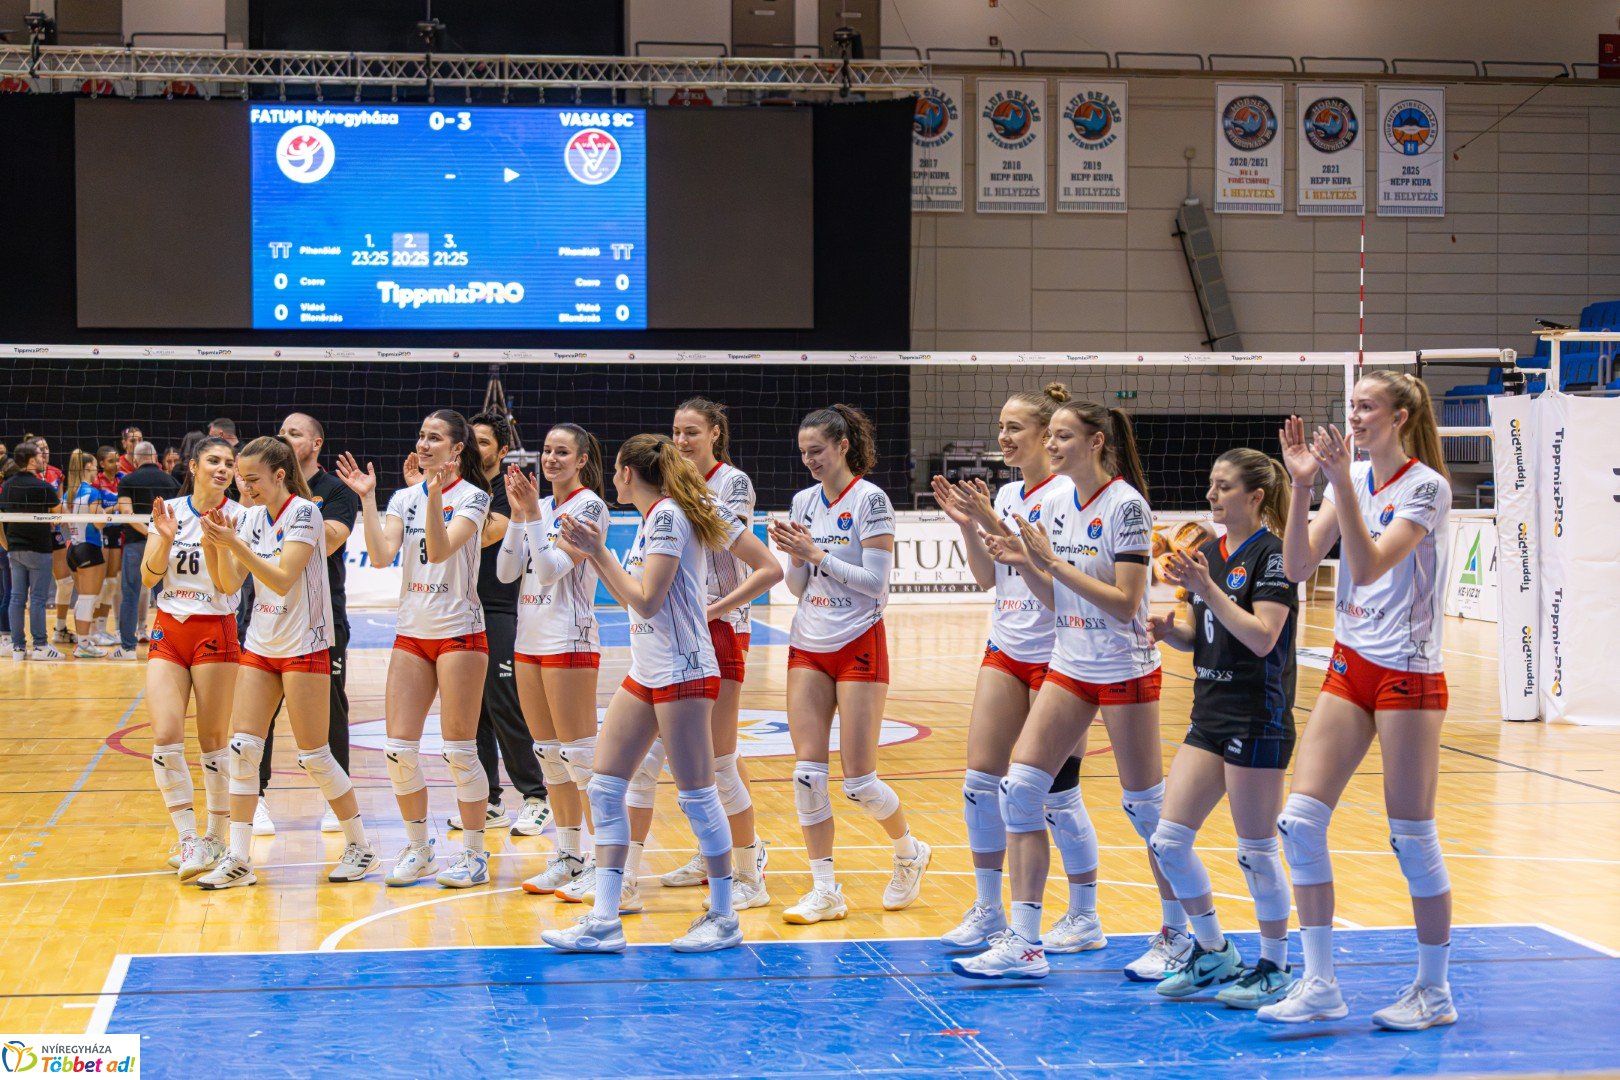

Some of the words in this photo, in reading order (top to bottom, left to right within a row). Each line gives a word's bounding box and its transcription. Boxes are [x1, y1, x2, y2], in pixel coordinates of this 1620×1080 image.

[250, 109, 302, 124] FATUM
[305, 109, 399, 127] Nyíregyháza
[559, 112, 610, 127] VASAS
[612, 112, 634, 127] SC
[1083, 161, 1102, 170] 2019
[1402, 166, 1420, 175] 2025
[912, 171, 928, 180] EPP
[991, 173, 1011, 181] HEPP
[1013, 173, 1033, 181] KUPA
[1071, 173, 1091, 181] HEPP
[1311, 176, 1330, 184] HEPP
[1332, 177, 1351, 185] KUPA
[364, 233, 375, 248] 1.
[404, 233, 417, 248] 2.
[443, 233, 457, 248] 3.
[351, 251, 389, 266] 23:25
[392, 251, 429, 266] 20:25
[433, 251, 468, 266] 21:25
[274, 273, 288, 289] 0
[615, 274, 630, 291] 0
[376, 280, 524, 309] TippmixPRO
[274, 304, 288, 321] 0
[615, 304, 630, 321] 0
[1510, 419, 1526, 490] TippmixPRO
[1552, 428, 1565, 537] TippmixPRO
[176, 550, 200, 575] 26
[1518, 522, 1530, 592] TippmixPRO
[1204, 609, 1214, 643] 6
[1522, 625, 1535, 697] TippmixPRO
